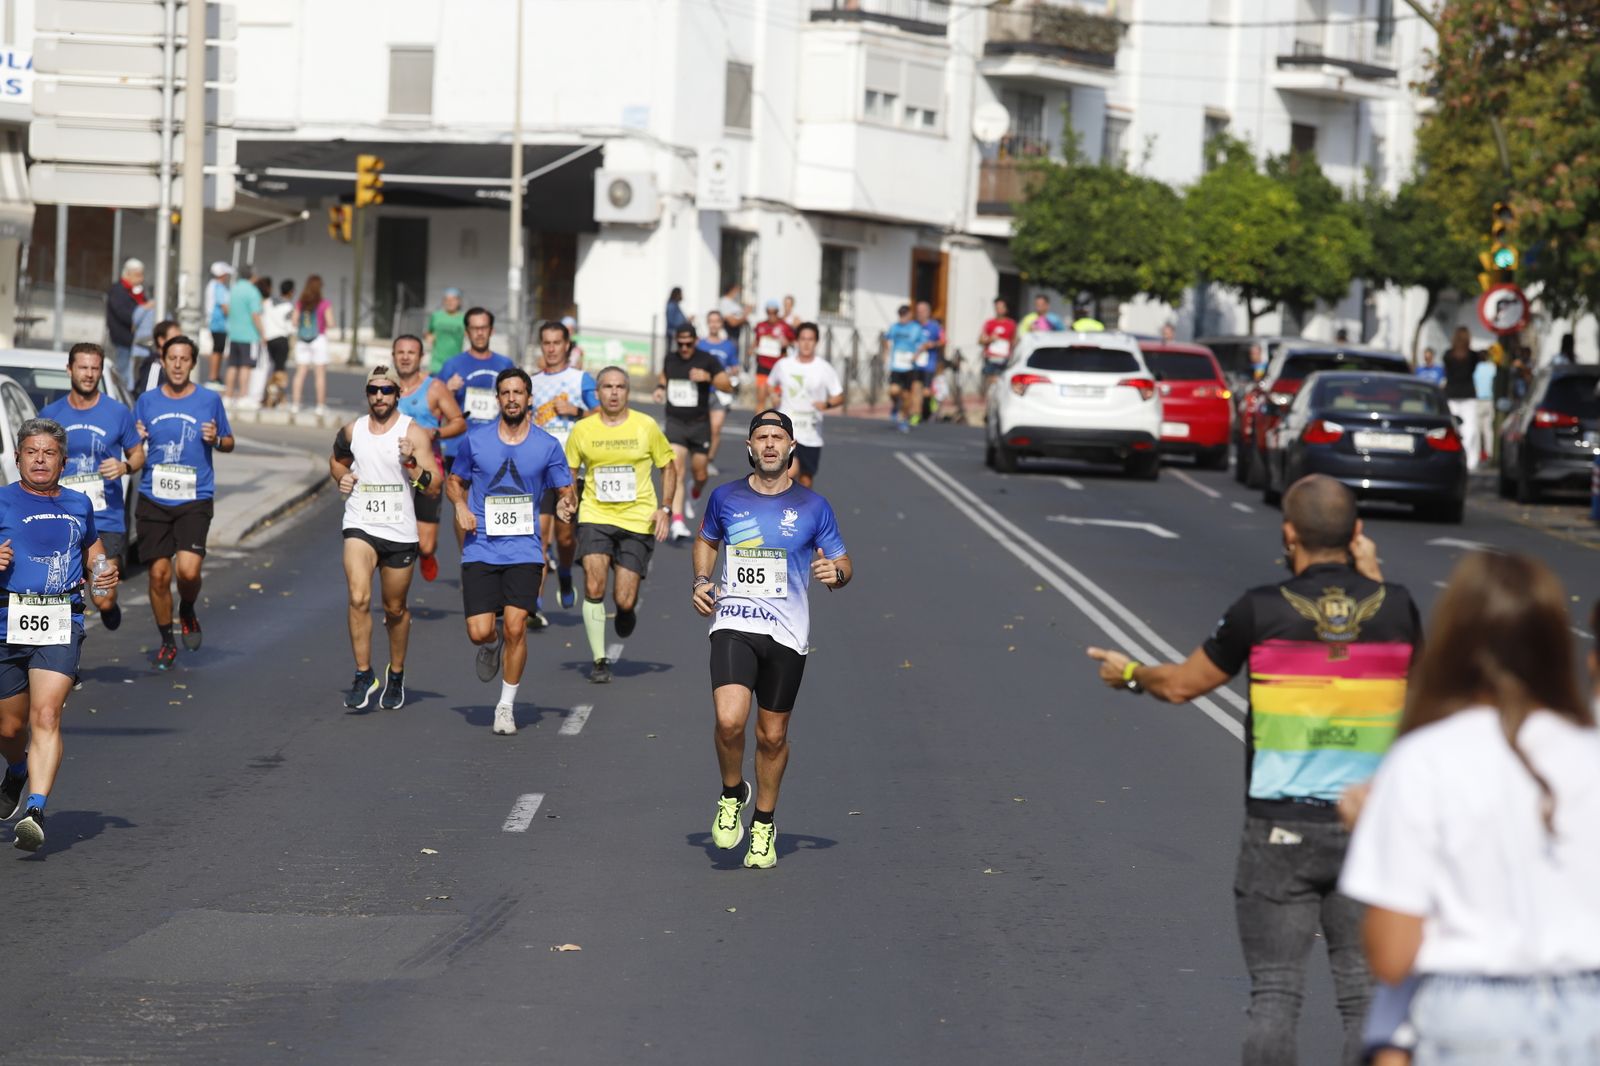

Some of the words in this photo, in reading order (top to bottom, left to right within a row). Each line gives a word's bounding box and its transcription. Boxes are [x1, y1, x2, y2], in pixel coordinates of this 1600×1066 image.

[0, 52, 33, 70] LA
[606, 439, 638, 447] RUNNERS
[160, 479, 181, 491] 665
[602, 480, 621, 492] 613
[366, 500, 386, 512] 431
[495, 512, 517, 525] 385
[762, 550, 783, 558] HUELVA
[738, 567, 765, 584] 685
[720, 604, 778, 626] HUELVA
[20, 615, 49, 631] 656
